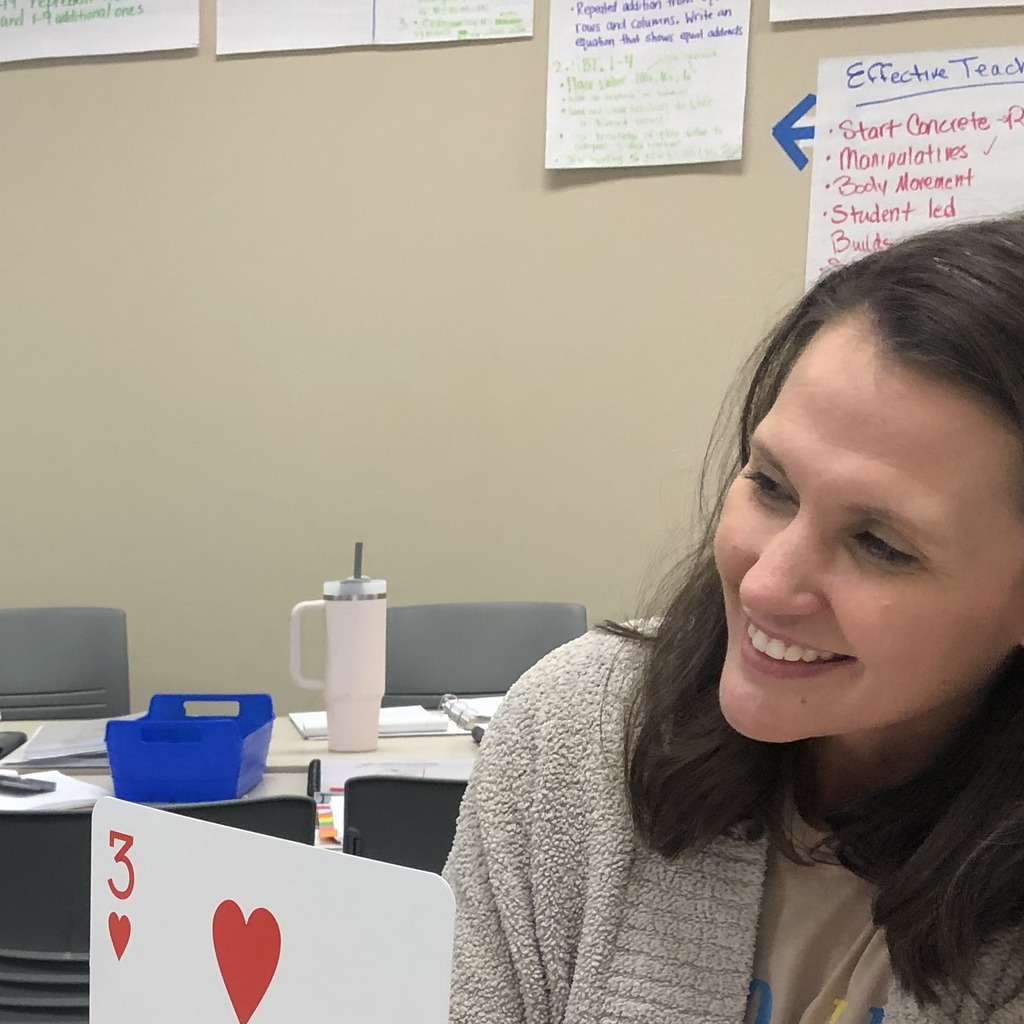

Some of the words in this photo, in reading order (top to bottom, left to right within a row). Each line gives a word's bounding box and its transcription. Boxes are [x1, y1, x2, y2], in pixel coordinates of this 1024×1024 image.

[0, 9, 25, 28] and
[114, 4, 145, 19] ones
[575, 21, 600, 33] rows
[606, 18, 626, 31] and
[684, 9, 714, 25] Write
[717, 8, 733, 18] an
[576, 0, 617, 18] Repeated
[574, 35, 616, 52] equation
[619, 33, 641, 45] that
[645, 31, 674, 43] shows
[846, 60, 950, 89] Effective
[838, 117, 902, 142] Start
[906, 110, 991, 137] Concrete
[838, 144, 969, 172] Manipulatives
[832, 175, 888, 198] Body
[895, 167, 976, 195] Movement
[831, 201, 918, 225] Student
[928, 196, 957, 219] led
[107, 829, 136, 899] 3
